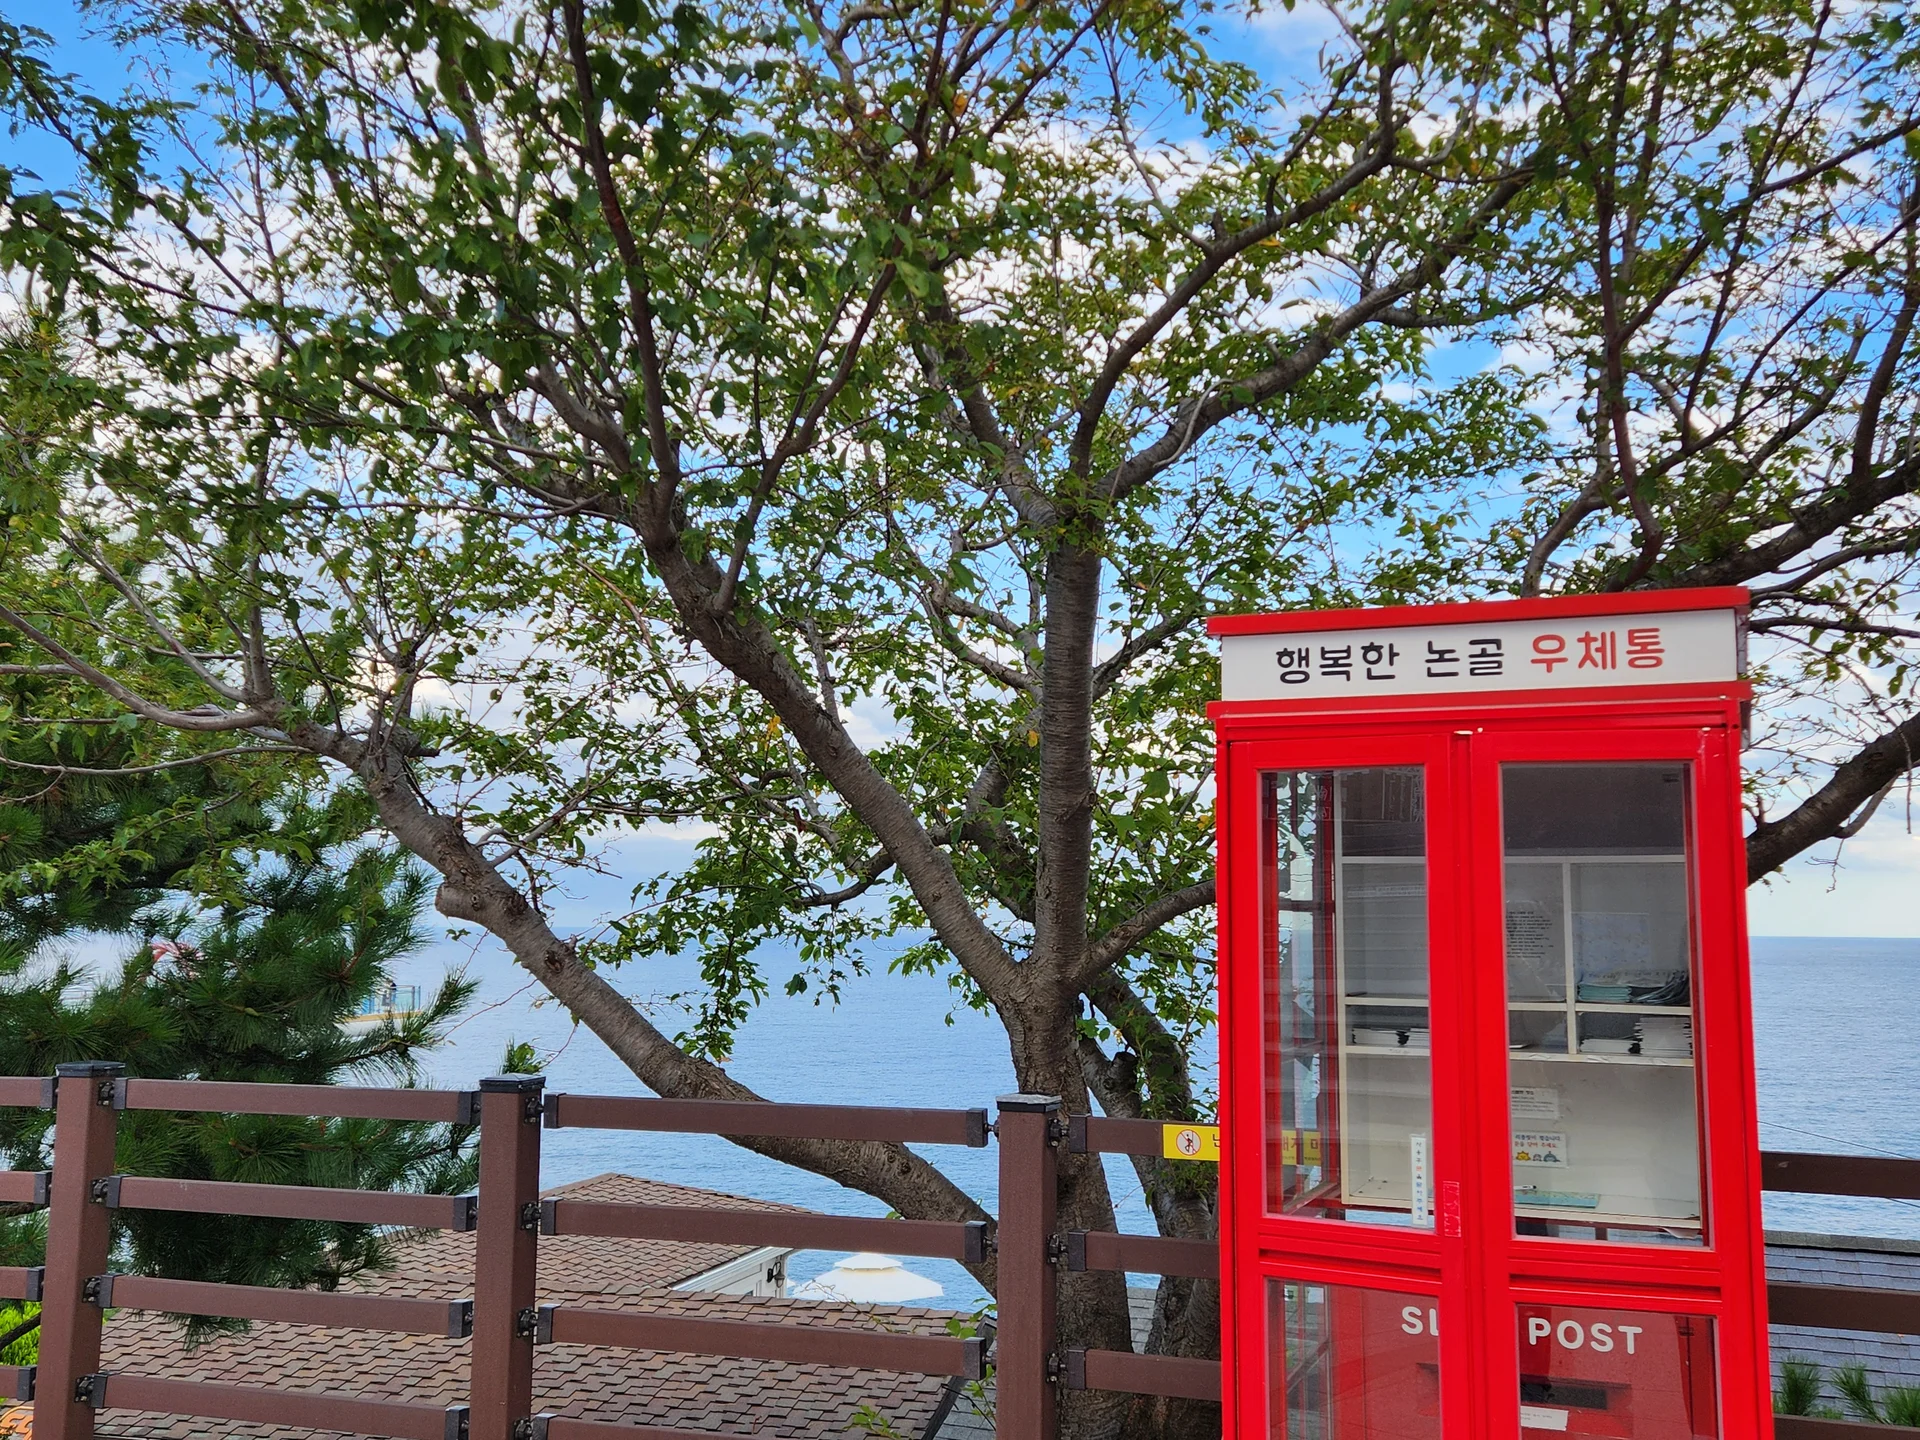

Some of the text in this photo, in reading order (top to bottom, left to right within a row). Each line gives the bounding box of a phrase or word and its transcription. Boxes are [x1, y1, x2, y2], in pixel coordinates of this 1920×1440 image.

[1276, 627, 1665, 684] 행복한 논골 우체통
[1401, 1306, 1643, 1355] SL POST
